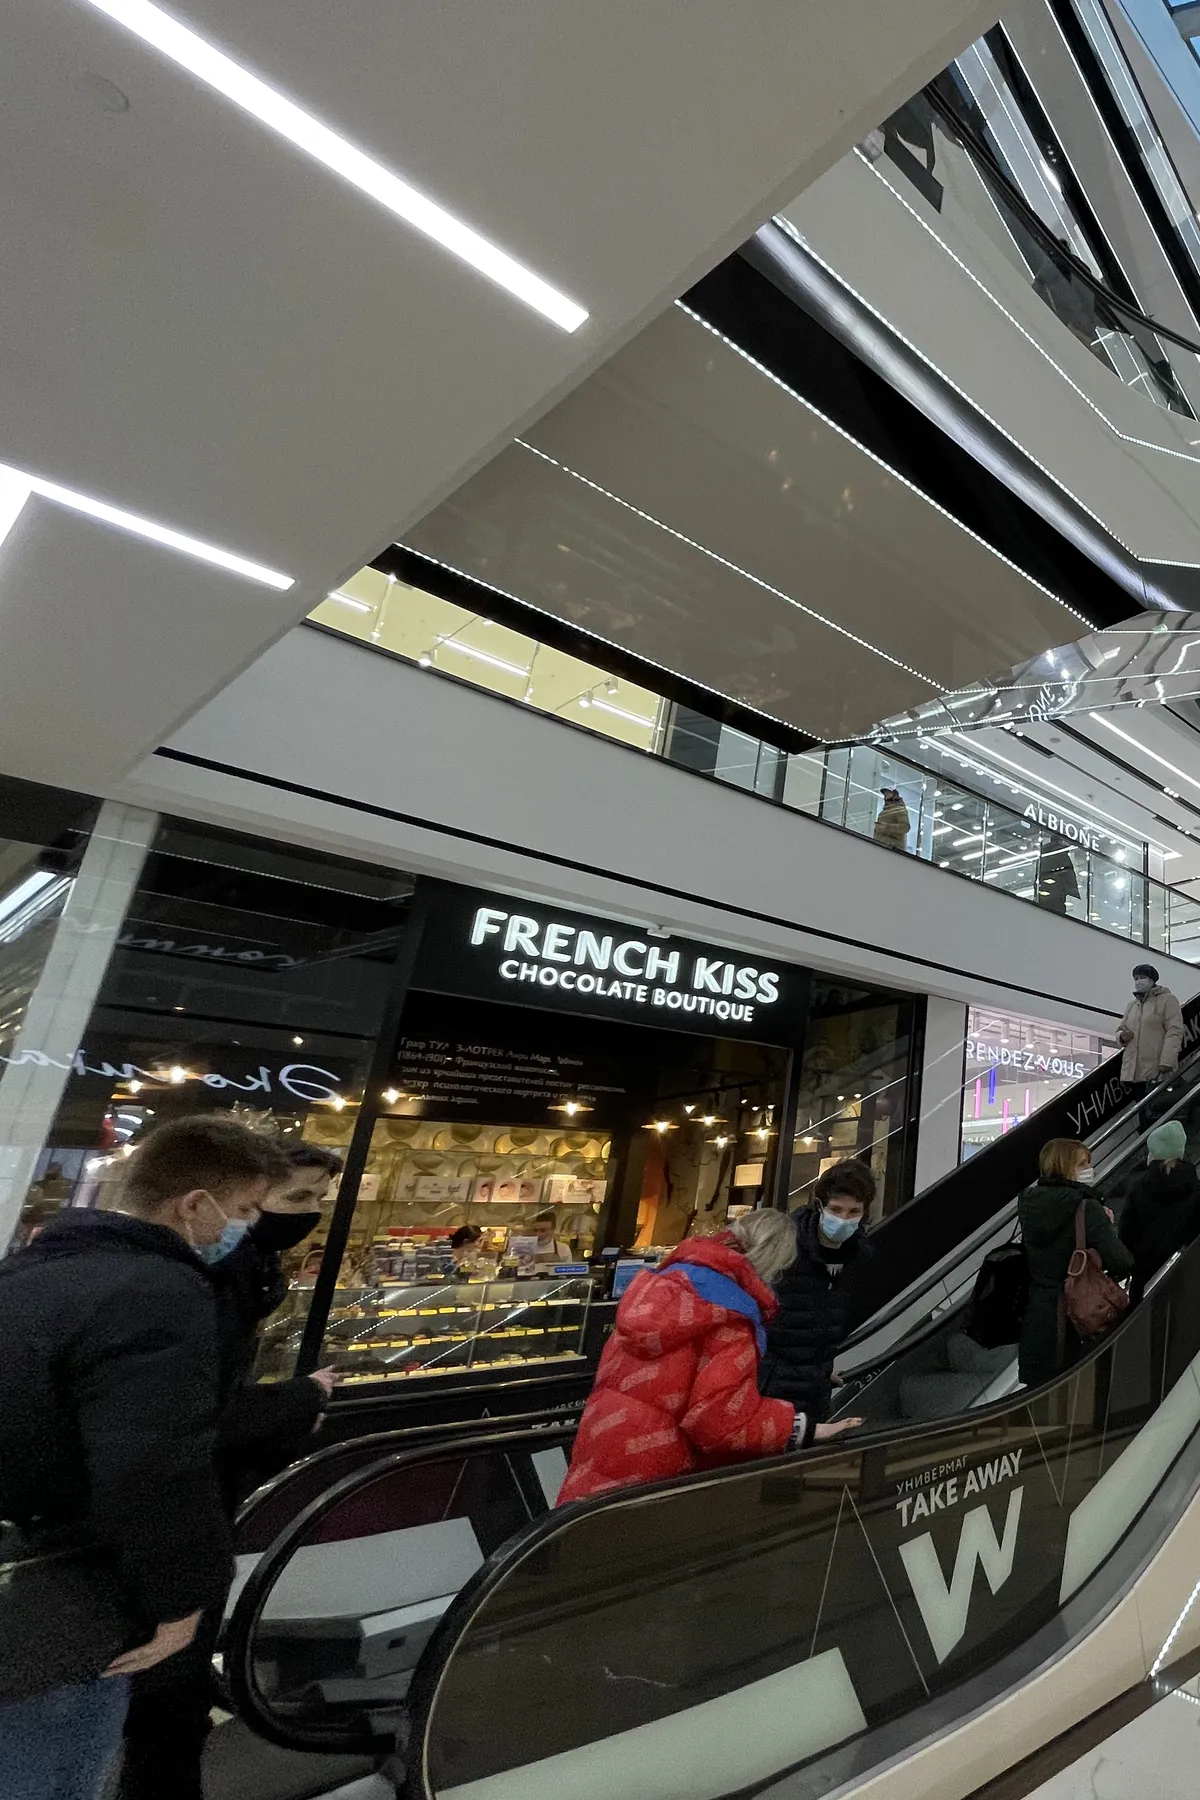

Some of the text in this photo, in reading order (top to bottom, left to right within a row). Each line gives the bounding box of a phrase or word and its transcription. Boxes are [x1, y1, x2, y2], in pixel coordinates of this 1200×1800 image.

[1023, 803, 1101, 851] ALBIONE
[470, 907, 780, 1004] FRENCH KISS
[499, 959, 754, 1022] CHOCOLATE BOUTIQUE
[896, 1455, 968, 1496] УНИВЕРМАГ
[896, 1448, 1023, 1527] TAKE AWAY
